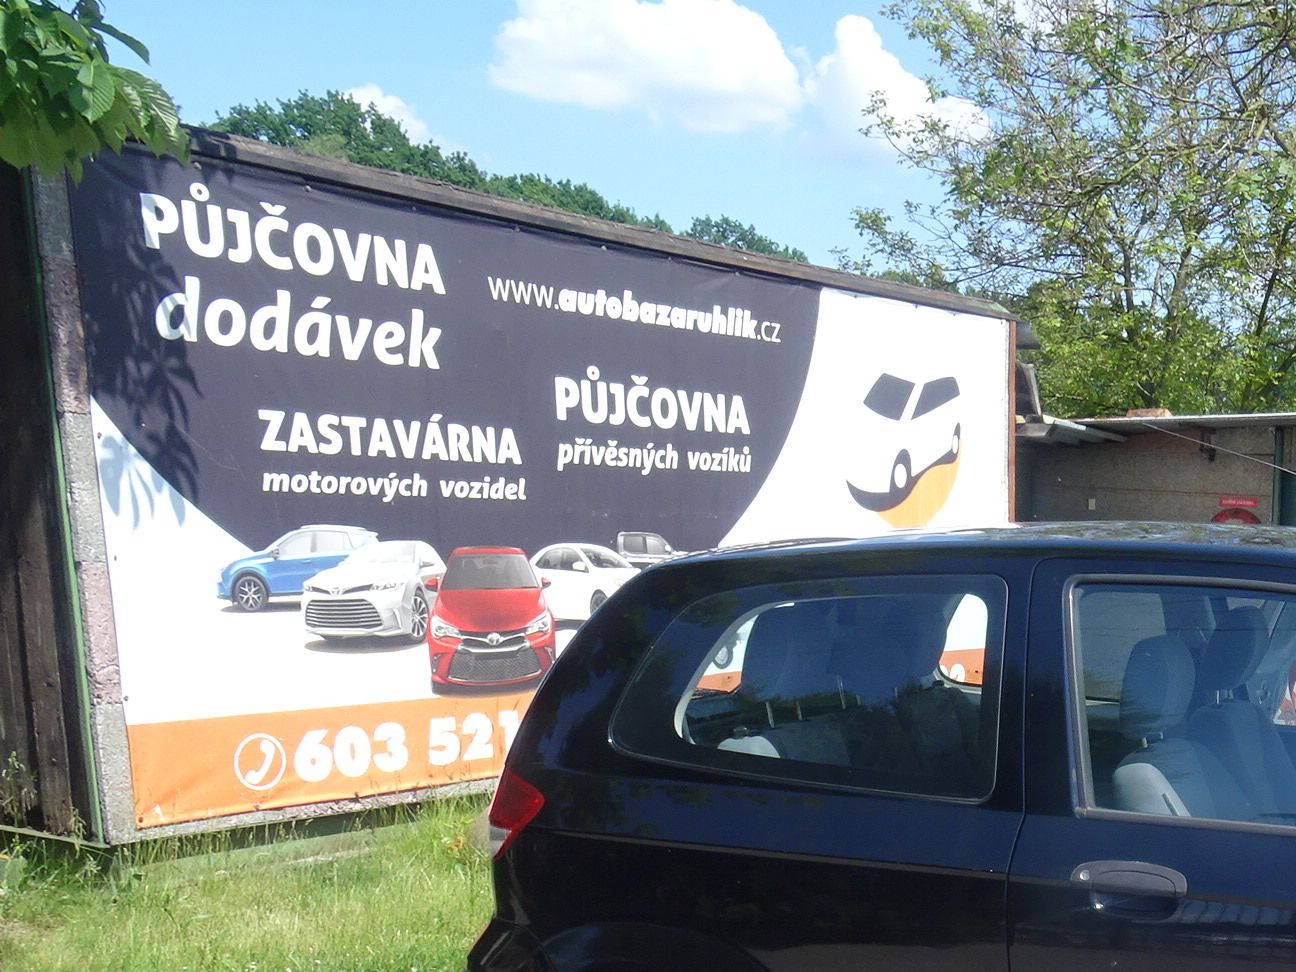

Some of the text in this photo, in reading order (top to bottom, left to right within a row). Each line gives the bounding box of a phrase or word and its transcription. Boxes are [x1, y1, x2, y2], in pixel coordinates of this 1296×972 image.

[139, 181, 447, 296] PŮJČOVNA
[155, 275, 443, 370] dodávek
[487, 275, 782, 345] www.autobazaruhlik.cz
[554, 365, 751, 436] PŮJČOVNA
[257, 408, 523, 466] ZASTAVÁRNA
[556, 437, 752, 476] přívěsných vozíků
[262, 470, 527, 503] motorových vozidel
[293, 721, 409, 782] 603
